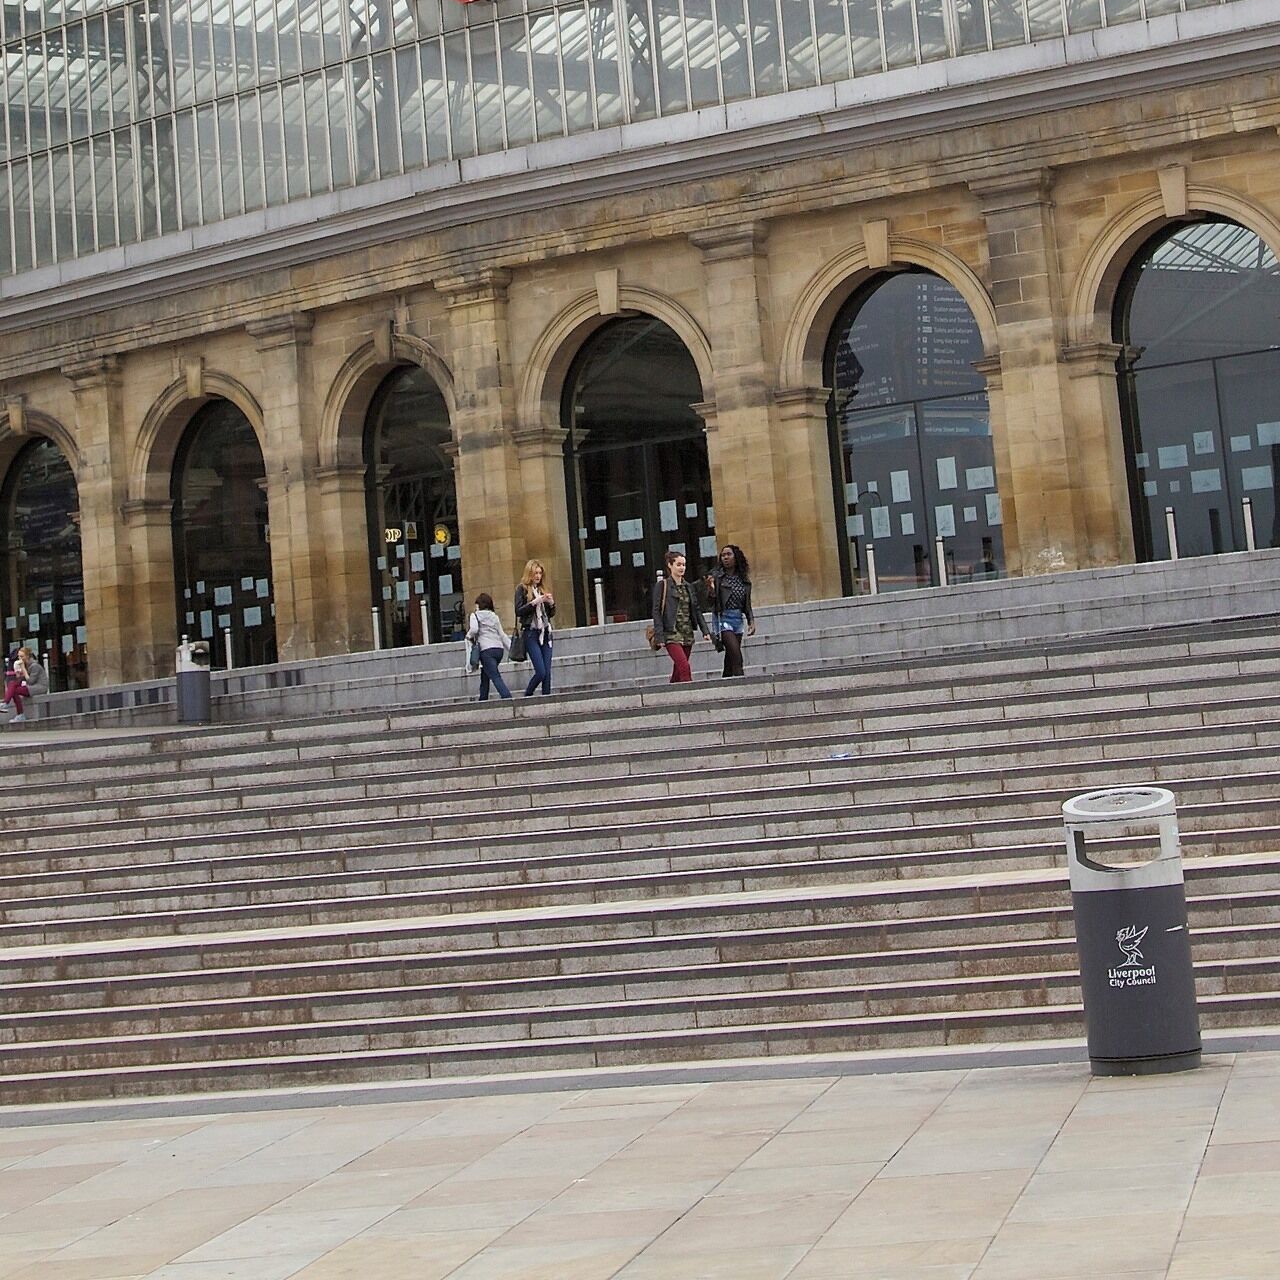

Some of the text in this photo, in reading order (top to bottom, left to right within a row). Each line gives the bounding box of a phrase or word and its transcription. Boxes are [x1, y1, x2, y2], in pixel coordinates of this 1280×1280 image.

[1108, 965, 1156, 980] Liverpool
[1109, 976, 1156, 989] City Council
